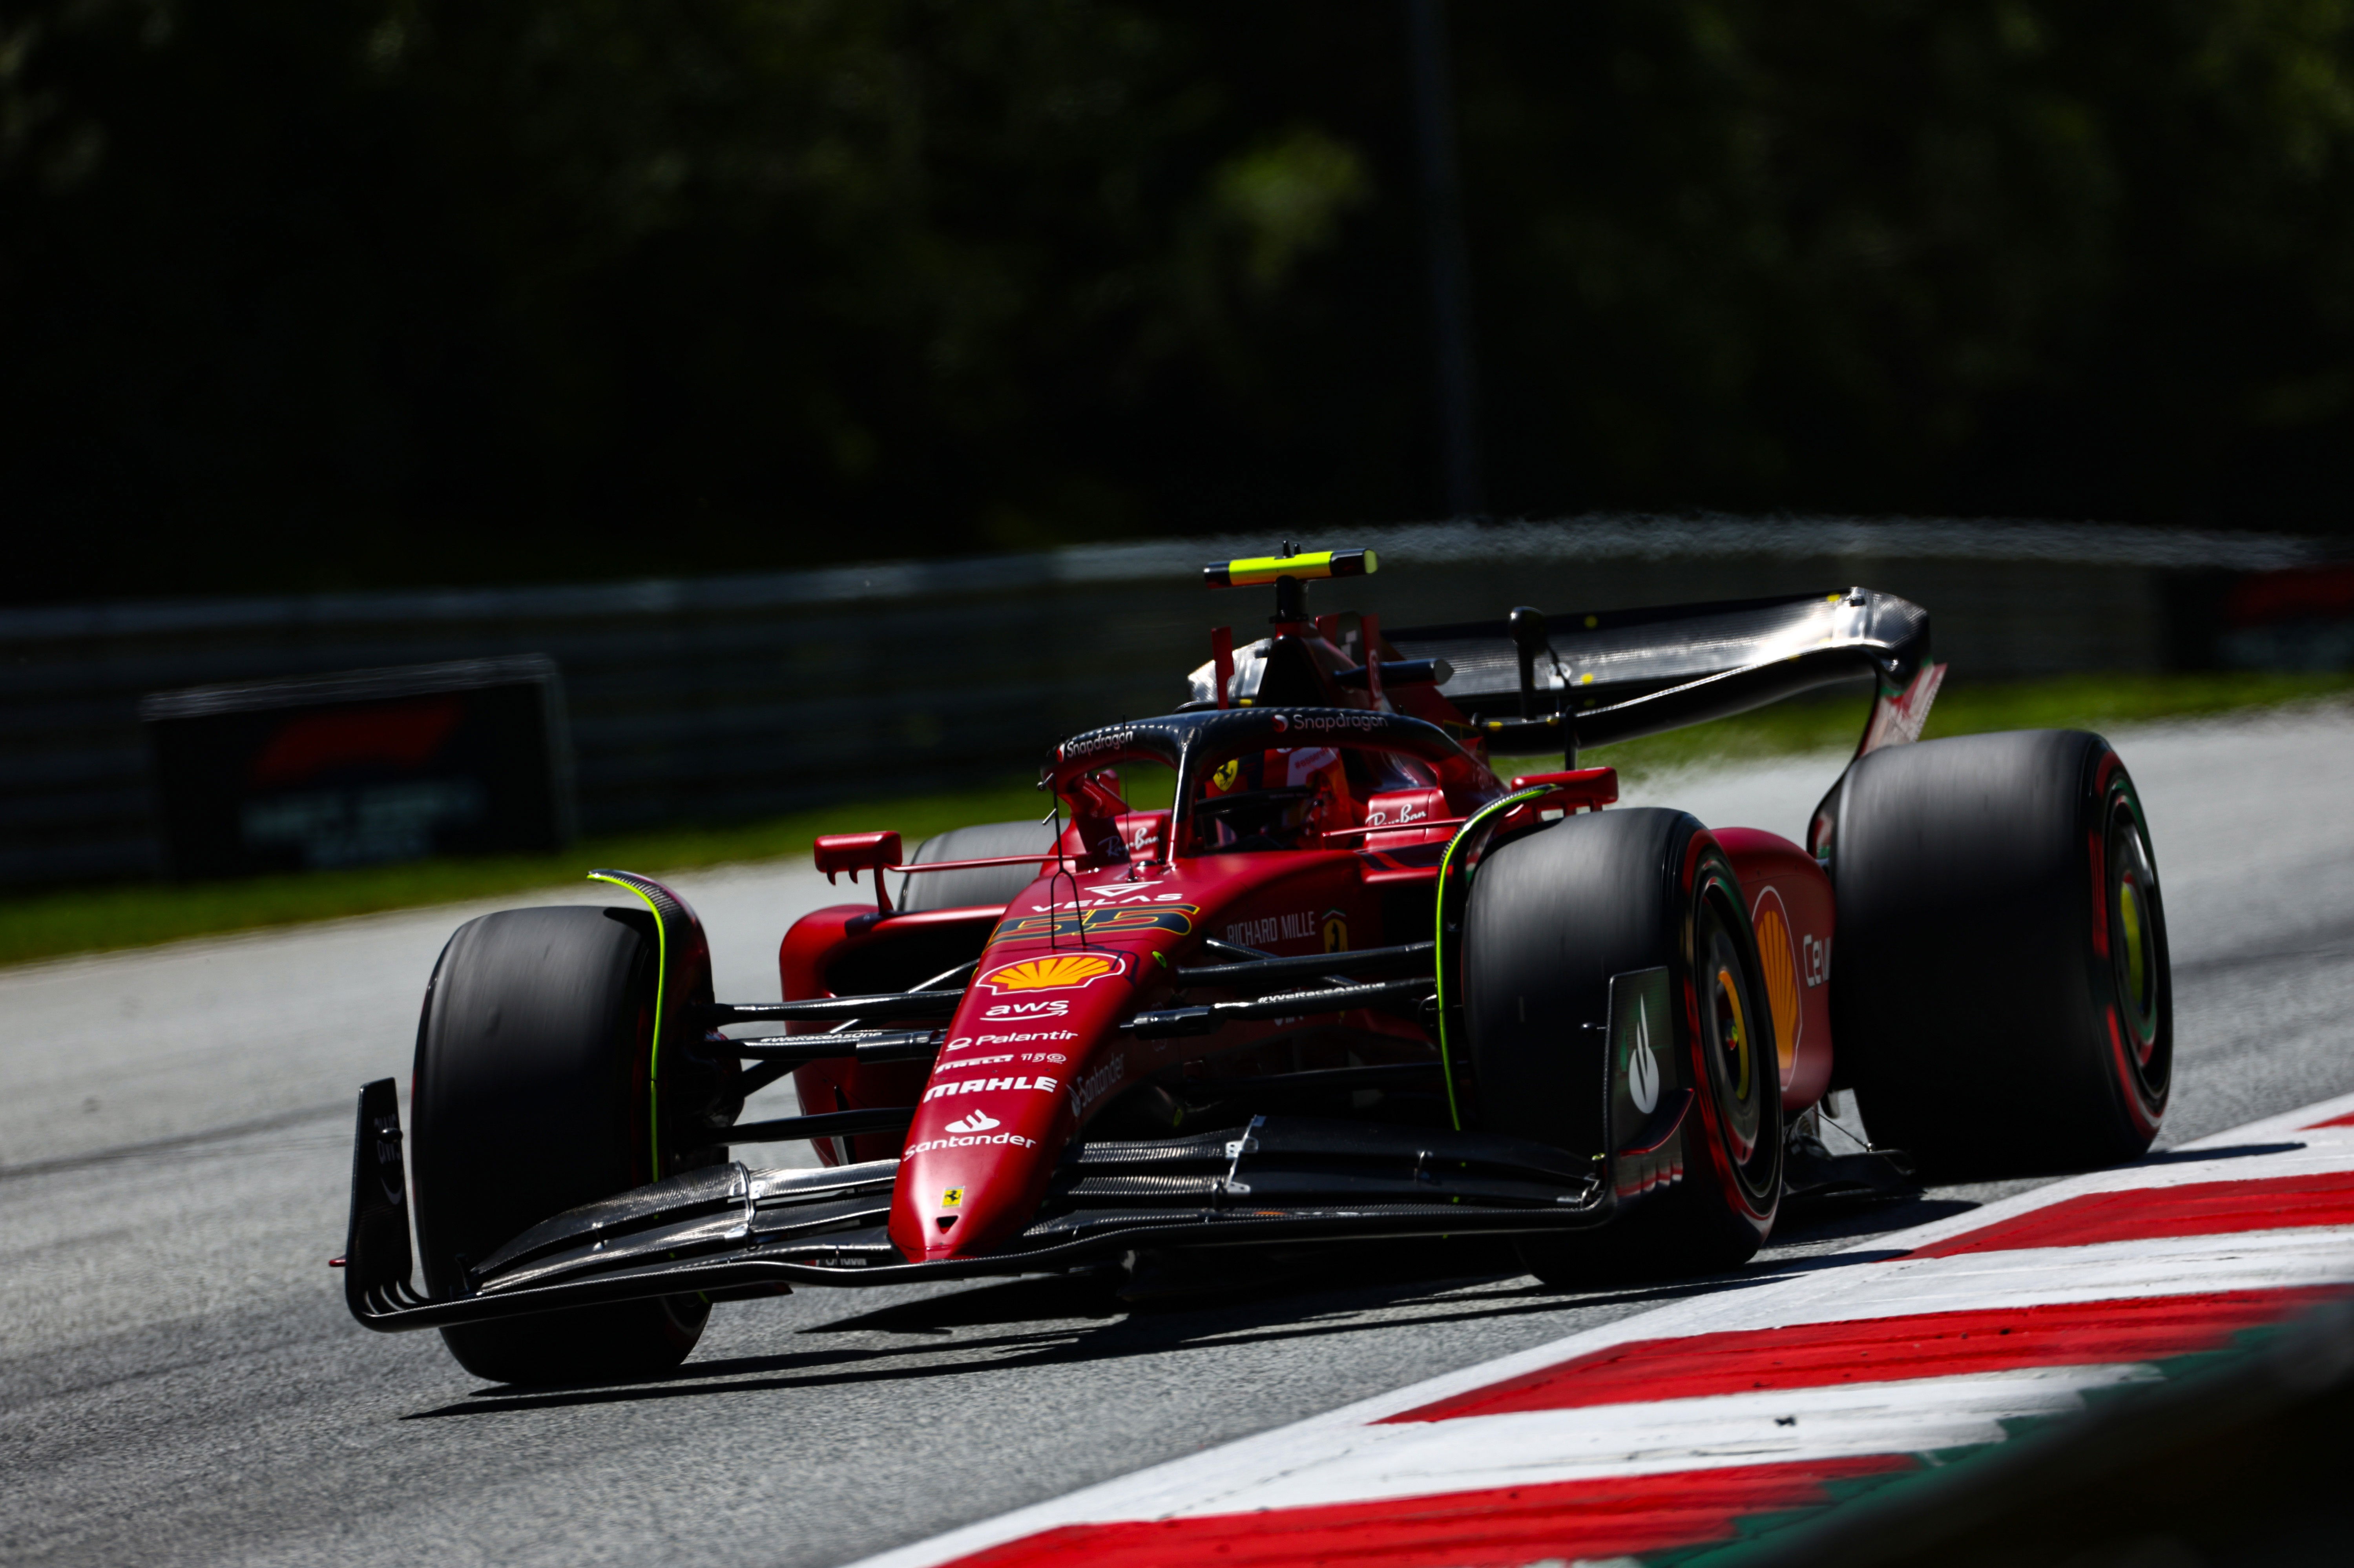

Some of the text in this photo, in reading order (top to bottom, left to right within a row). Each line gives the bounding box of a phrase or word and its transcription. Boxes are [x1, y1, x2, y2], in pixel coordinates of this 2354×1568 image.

[1293, 712, 1389, 732] Snapdragon
[1067, 731, 1133, 758] Snapdragon
[1032, 893, 1183, 912] VELAS
[980, 904, 1200, 958] 55
[1226, 910, 1316, 947] RICHARD MILLE
[985, 1000, 1069, 1016] aws
[976, 1030, 1078, 1046] Palantir
[935, 1054, 1015, 1074] PIRELLI
[923, 1076, 1058, 1103] MAHLE
[1076, 1052, 1125, 1108] Santander
[903, 1132, 1037, 1162] Santander
